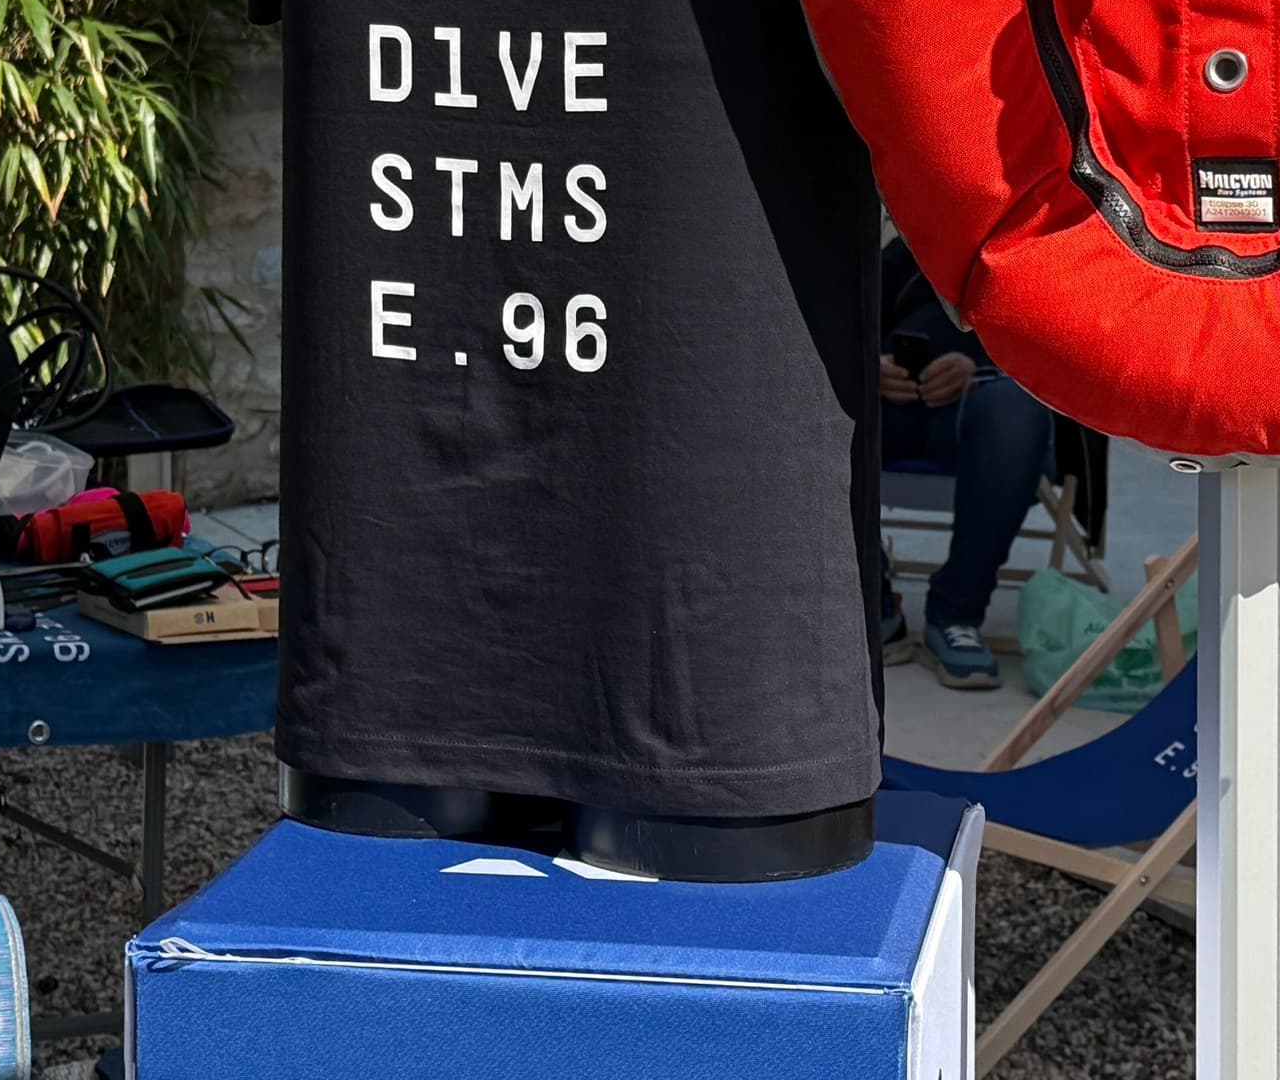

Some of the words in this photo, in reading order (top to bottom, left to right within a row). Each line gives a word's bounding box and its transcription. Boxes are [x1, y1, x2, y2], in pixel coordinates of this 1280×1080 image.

[369, 152, 608, 244] STMS
[1198, 169, 1273, 189] HALCYON
[369, 279, 608, 373] E.96
